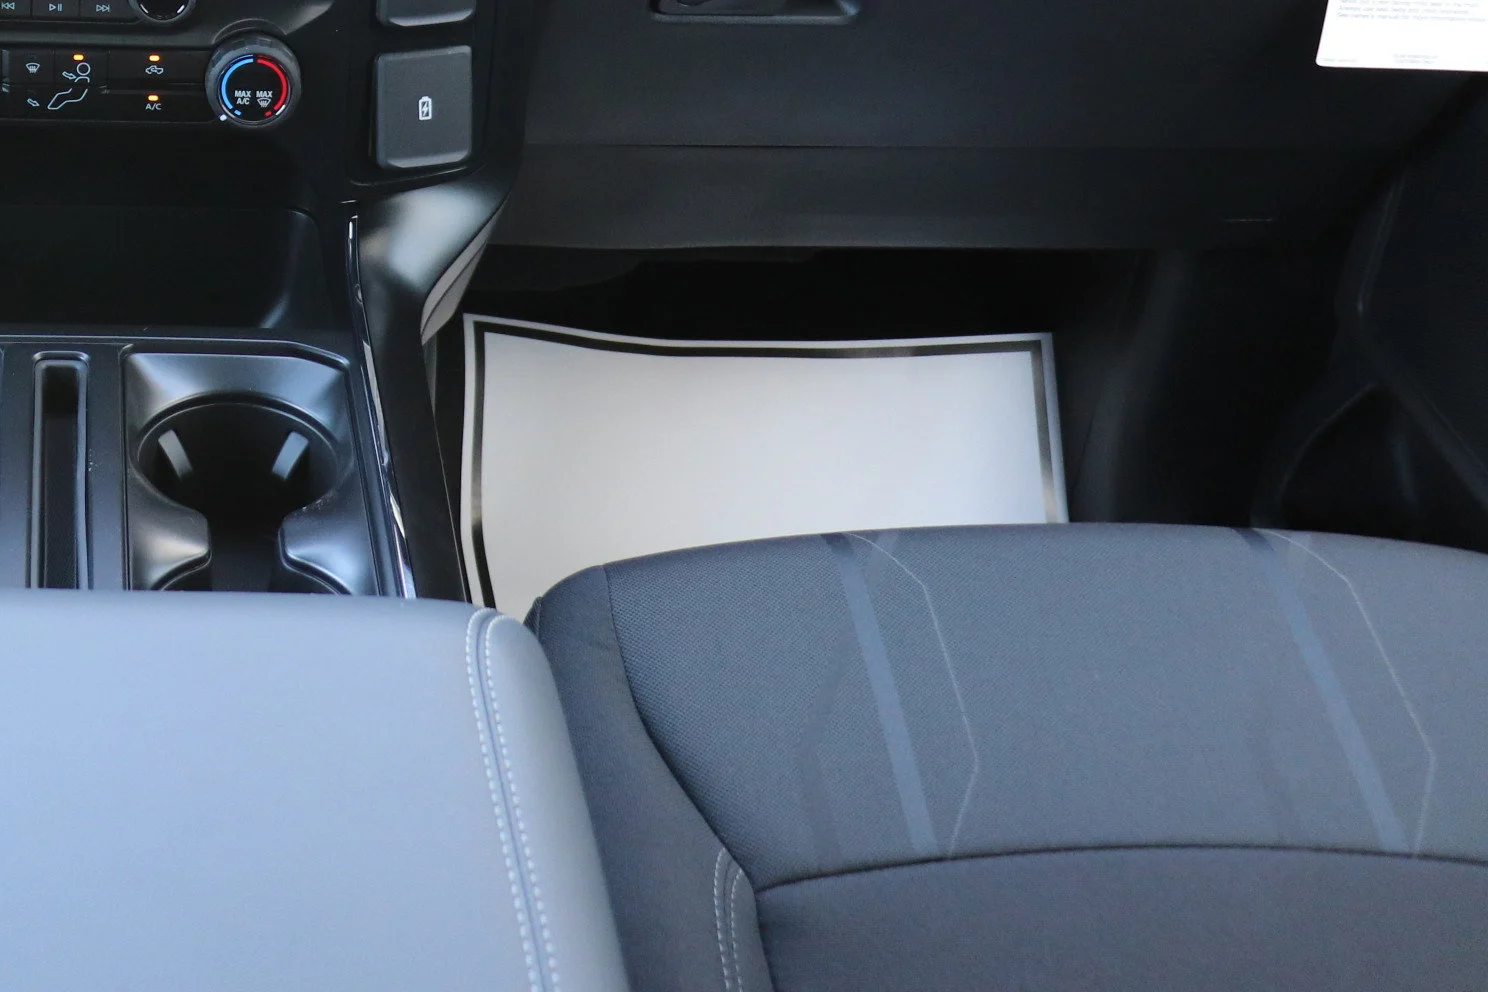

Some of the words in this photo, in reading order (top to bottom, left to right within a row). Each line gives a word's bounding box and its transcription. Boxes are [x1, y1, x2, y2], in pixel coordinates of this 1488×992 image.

[235, 90, 251, 98] MAX
[256, 90, 273, 98] MAX
[237, 97, 250, 106] A/C
[145, 103, 162, 111] A/C
